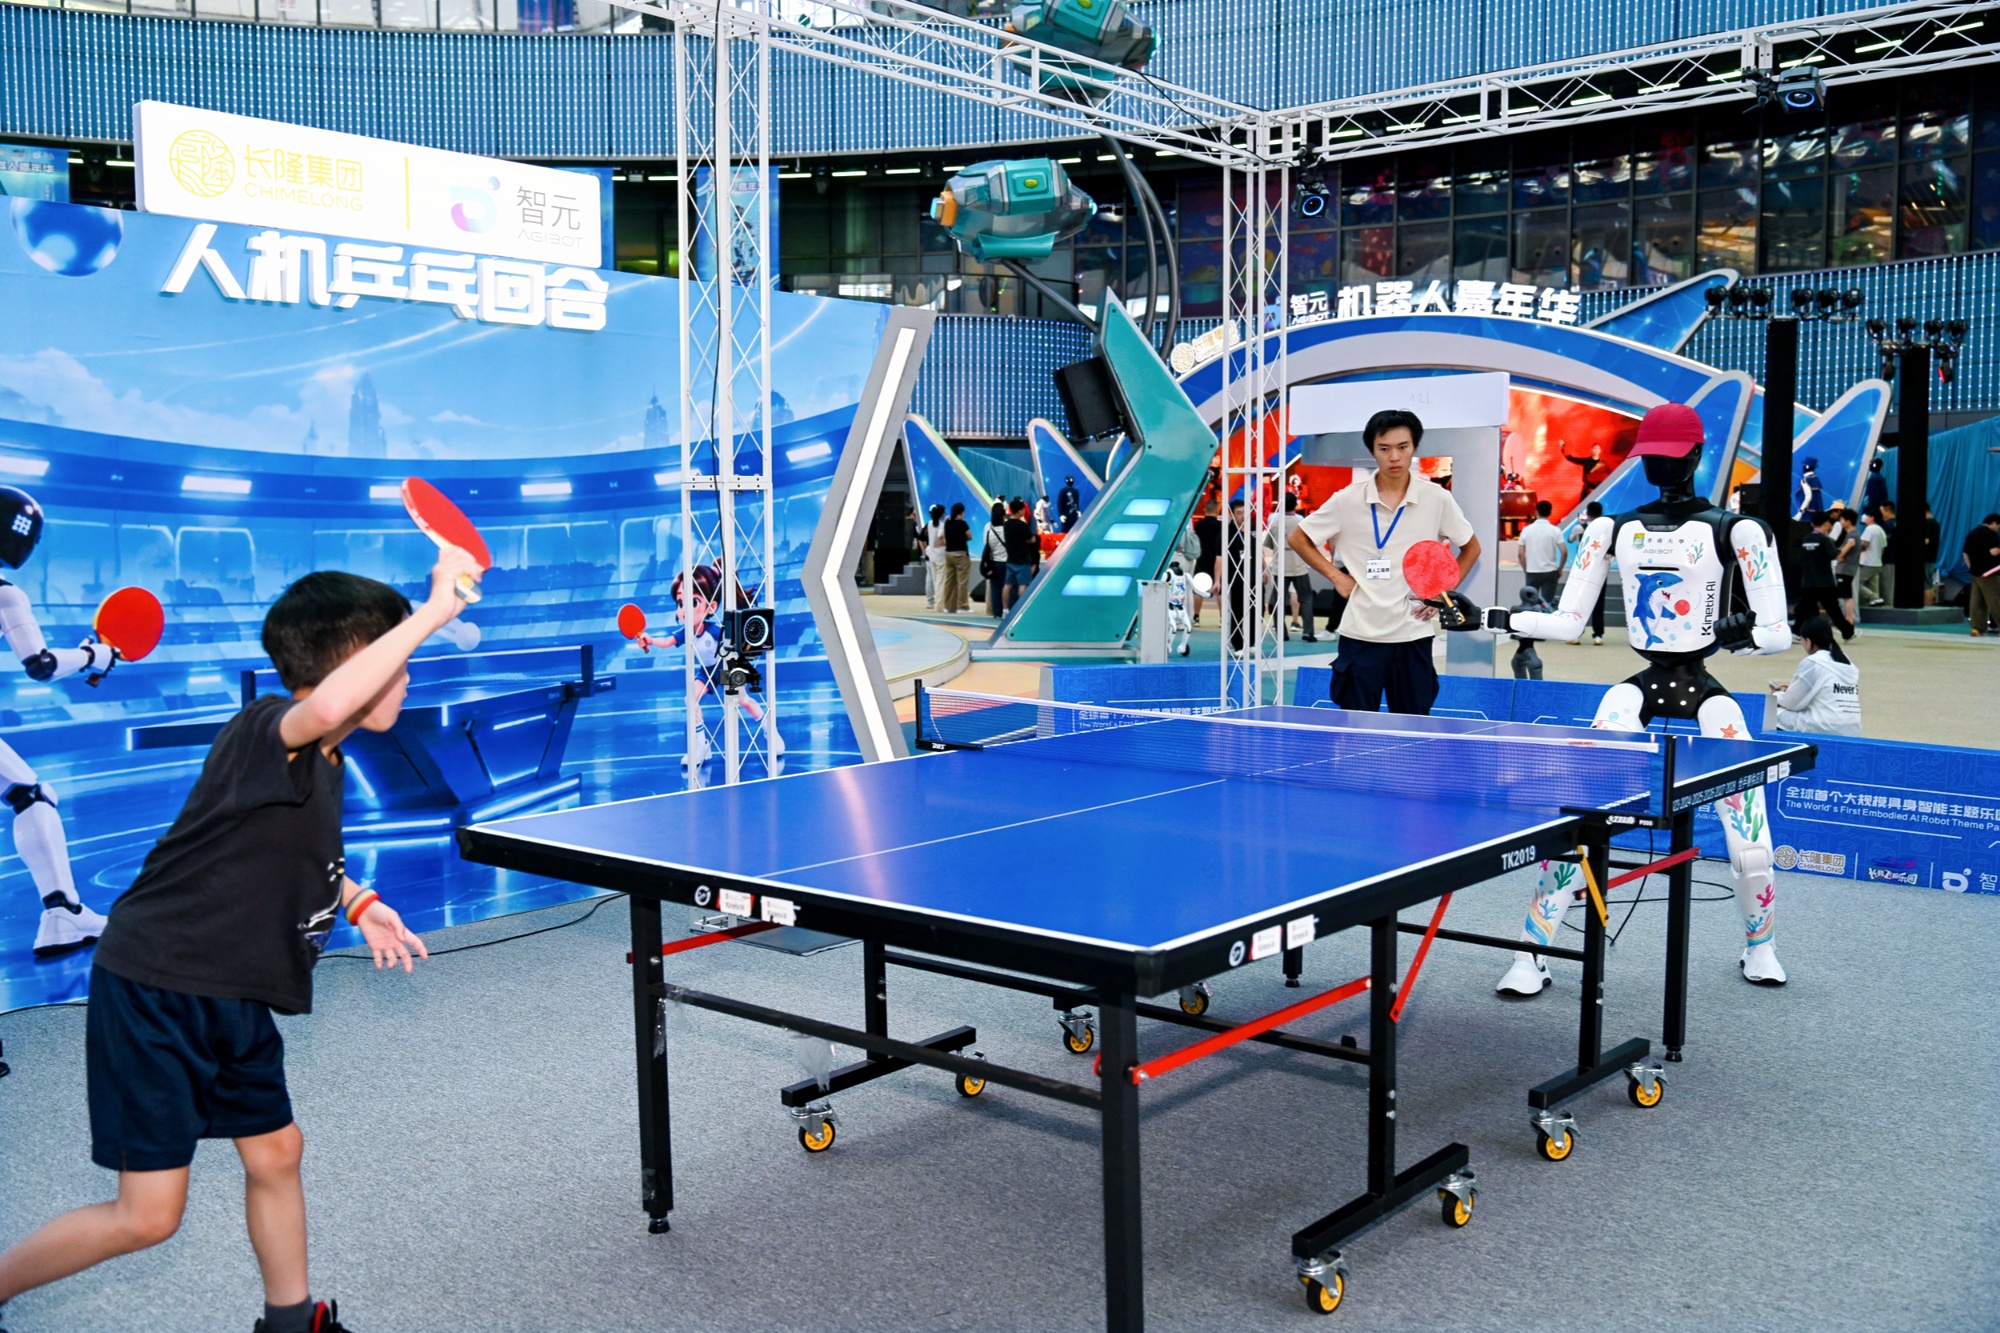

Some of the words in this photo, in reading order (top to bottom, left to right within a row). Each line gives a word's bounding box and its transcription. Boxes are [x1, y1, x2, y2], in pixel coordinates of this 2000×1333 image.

[243, 144, 362, 193] 长隆集团
[244, 182, 364, 212] CHIMELONG
[516, 185, 581, 231] 智元
[517, 229, 584, 248] AGIBOT
[160, 223, 610, 331] 人机乒乓回合
[1290, 291, 1328, 316] 智元
[1337, 279, 1582, 325] 机器人嘉年华
[1785, 799, 1802, 809] The
[1840, 806, 1861, 816] First
[1862, 808, 1909, 820] Embodied
[1909, 814, 1920, 822] AI
[1921, 815, 1950, 826] Robot
[1952, 818, 1985, 830] Theme
[1501, 845, 1536, 870] TK2019
[1799, 850, 1844, 868] 长隆集团
[1799, 862, 1843, 874] CHIMELONG
[1979, 872, 2000, 892] 智
